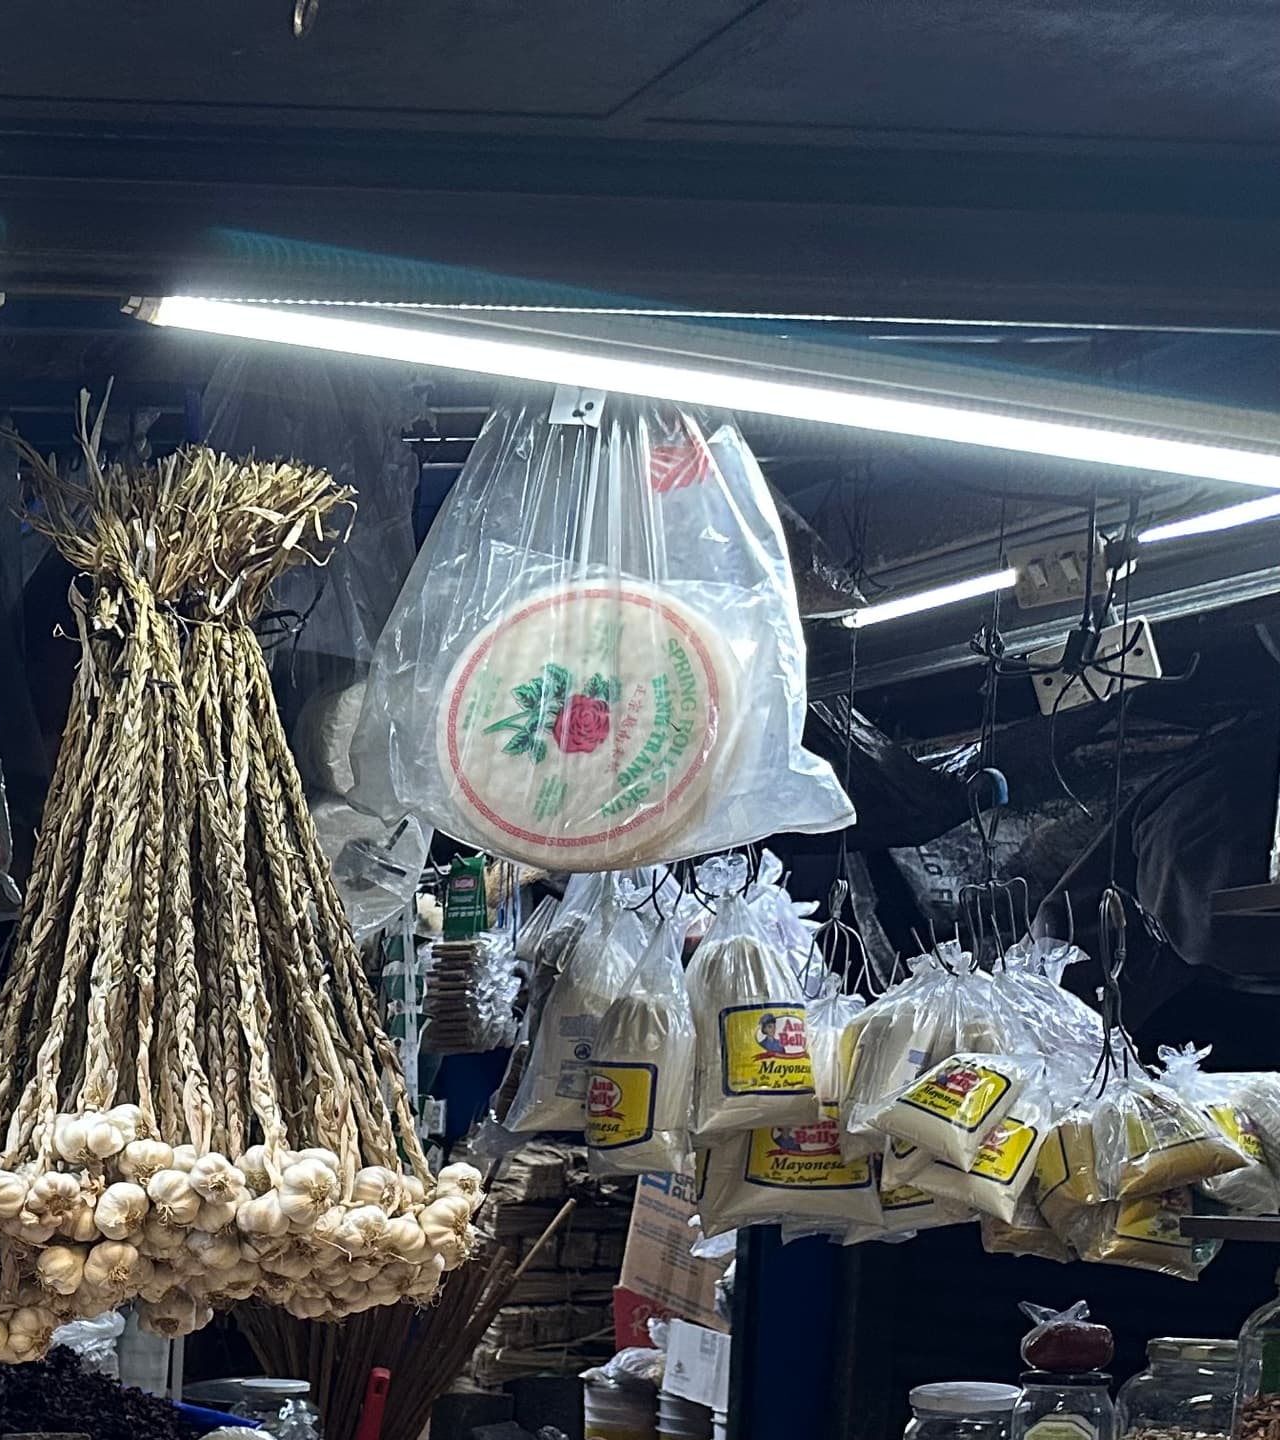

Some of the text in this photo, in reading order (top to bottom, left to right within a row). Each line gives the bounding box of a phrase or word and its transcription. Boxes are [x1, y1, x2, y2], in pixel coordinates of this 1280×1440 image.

[600, 638, 696, 818] SPRING ROLLS SKIN
